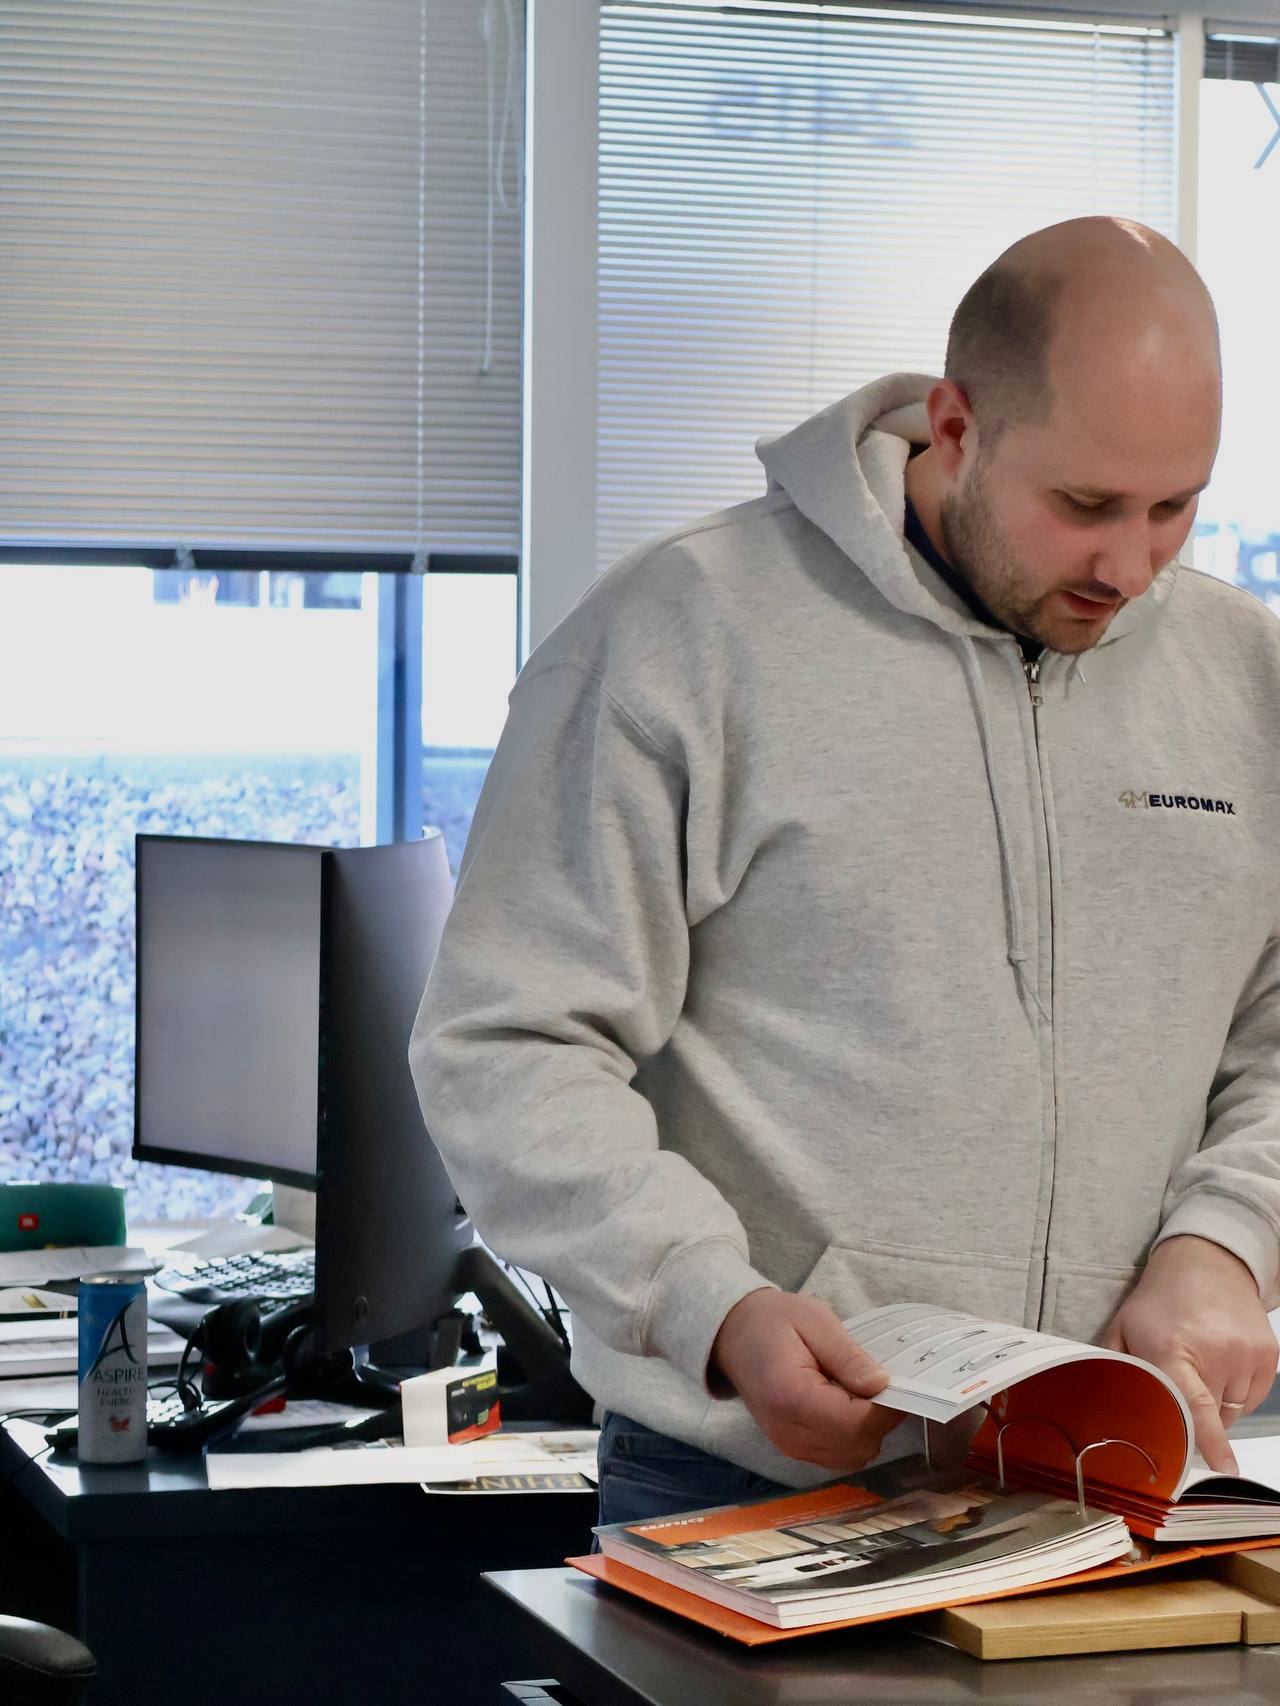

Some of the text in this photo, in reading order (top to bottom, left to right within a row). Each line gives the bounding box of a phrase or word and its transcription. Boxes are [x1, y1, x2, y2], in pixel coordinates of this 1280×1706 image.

[1149, 794, 1236, 815] EUROMAX
[93, 1367, 145, 1383] ASPIRE
[97, 1386, 142, 1397] HEALTH
[99, 1397, 138, 1407] ENERG
[460, 1474, 585, 1491] RHIN
